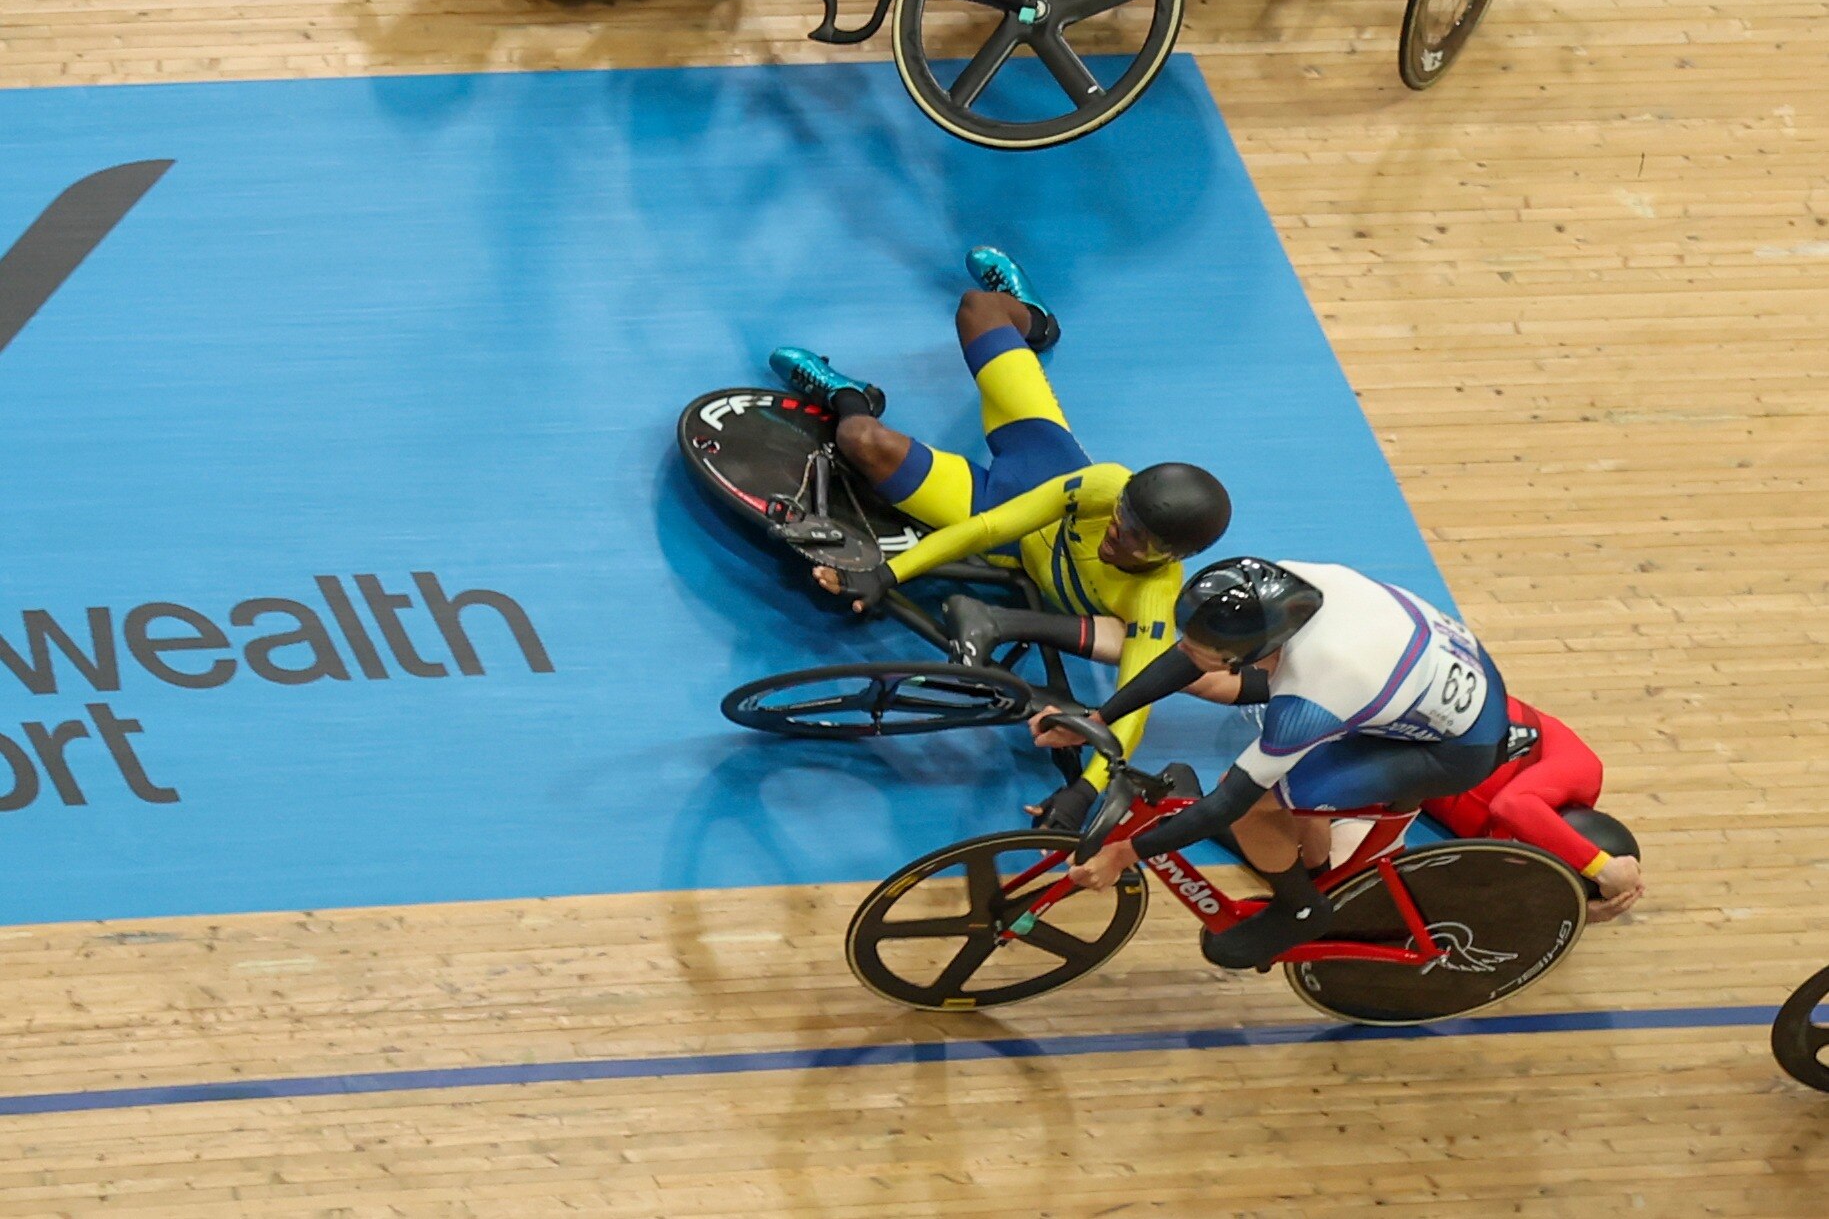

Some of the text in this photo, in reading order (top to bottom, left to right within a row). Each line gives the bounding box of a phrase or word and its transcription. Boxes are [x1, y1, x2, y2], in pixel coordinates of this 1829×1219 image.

[0, 571, 556, 694] wealth
[1441, 662, 1477, 714] 63
[1147, 853, 1220, 915] ervélo
